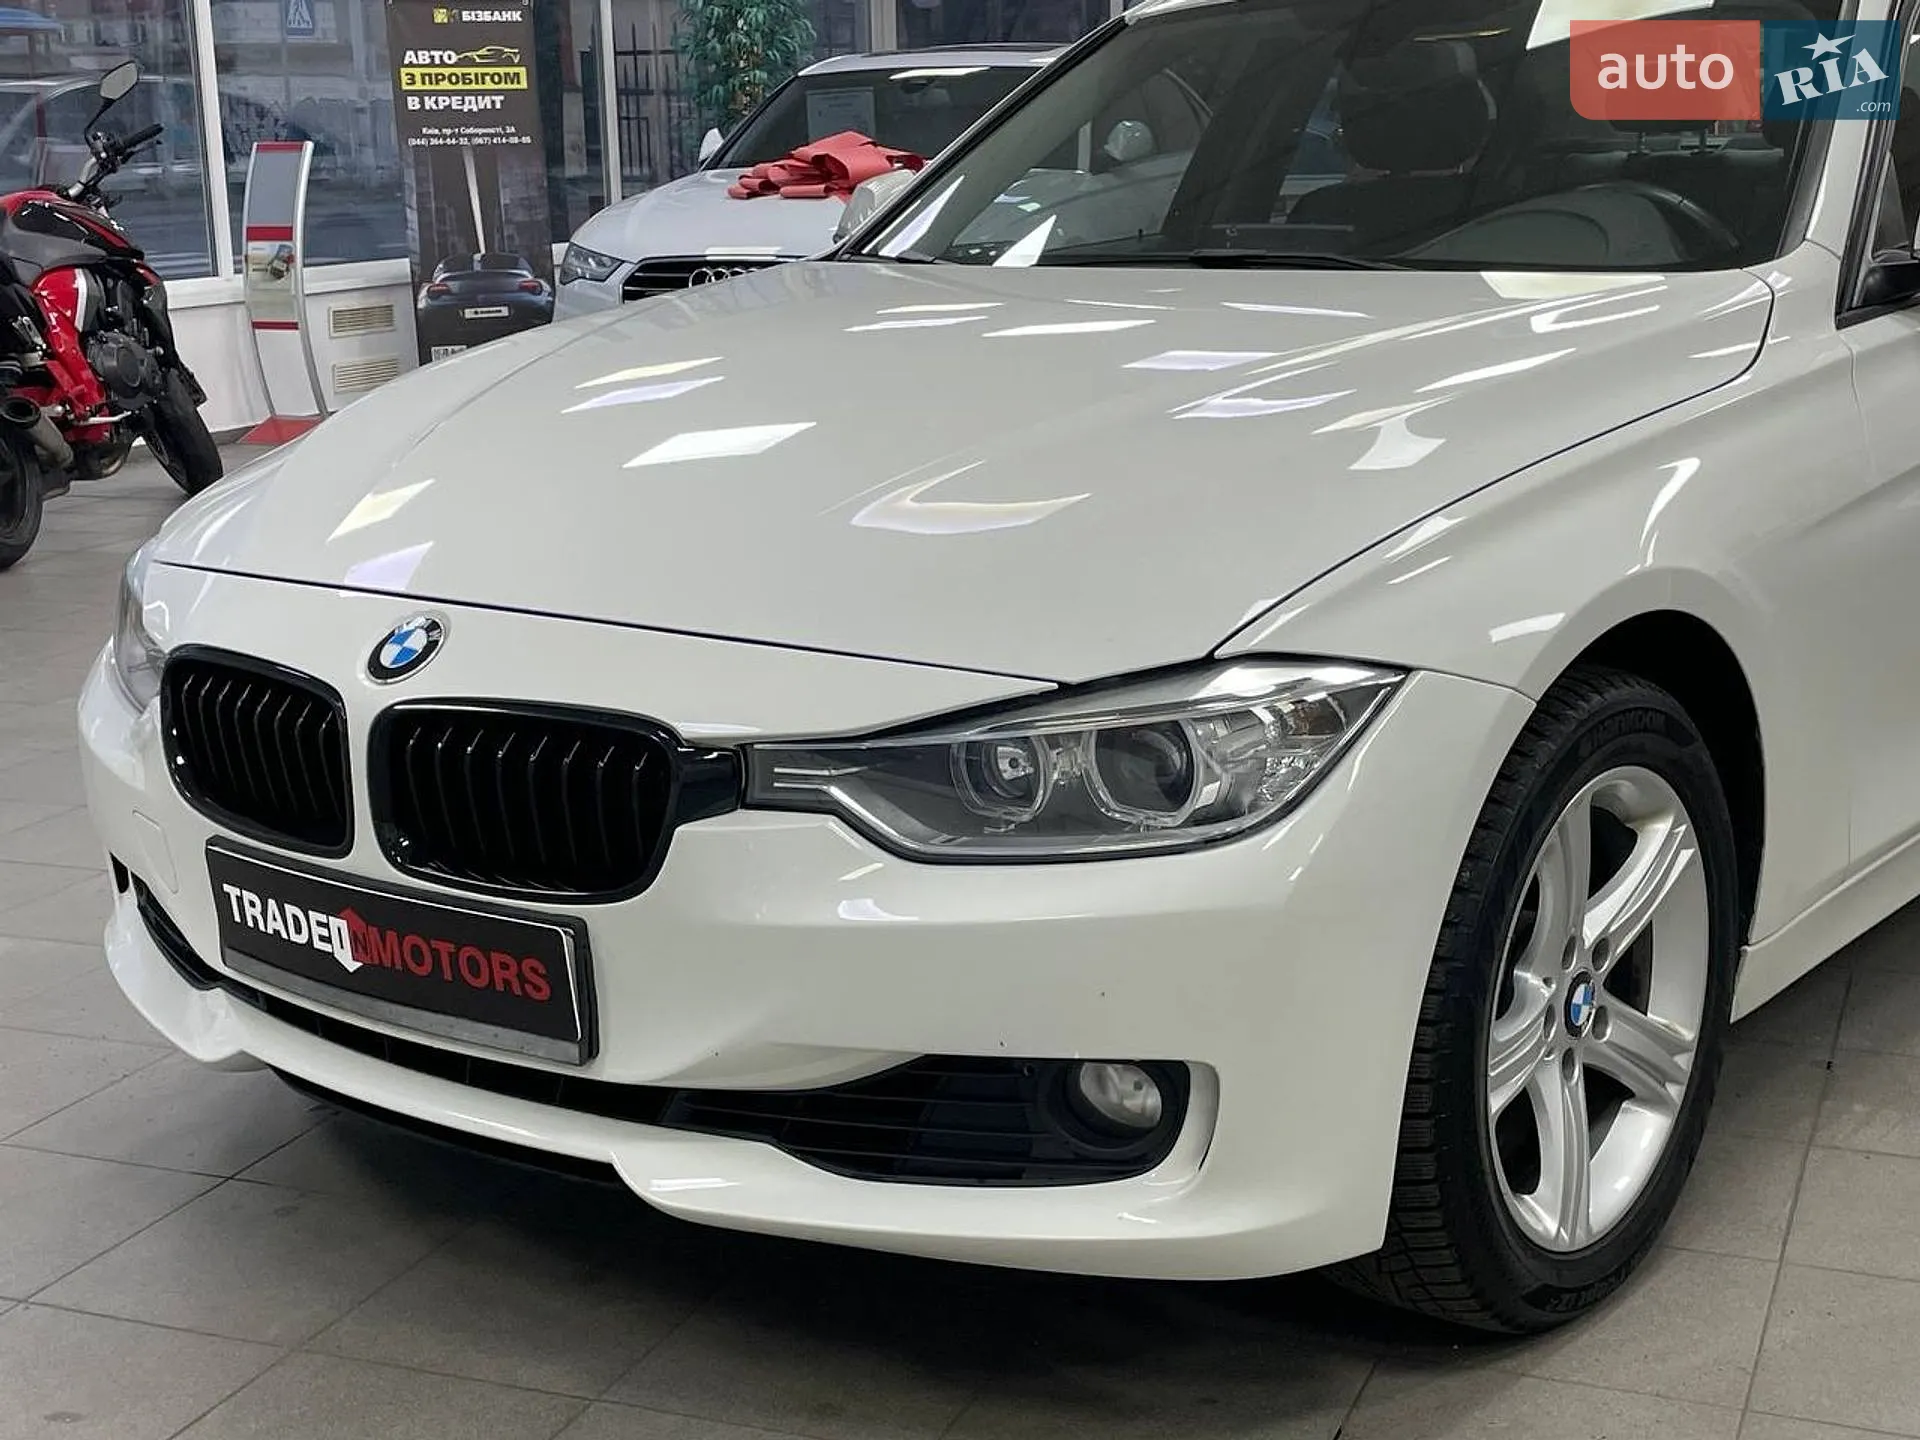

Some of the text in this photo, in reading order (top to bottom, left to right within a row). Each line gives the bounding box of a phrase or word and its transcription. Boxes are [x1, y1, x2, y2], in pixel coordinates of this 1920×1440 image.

[462, 10, 523, 22] БІЗБАНК
[403, 50, 457, 64] АВТО
[420, 72, 521, 86] ПРОБІГОМ
[406, 95, 505, 113] В КРЕДИТ
